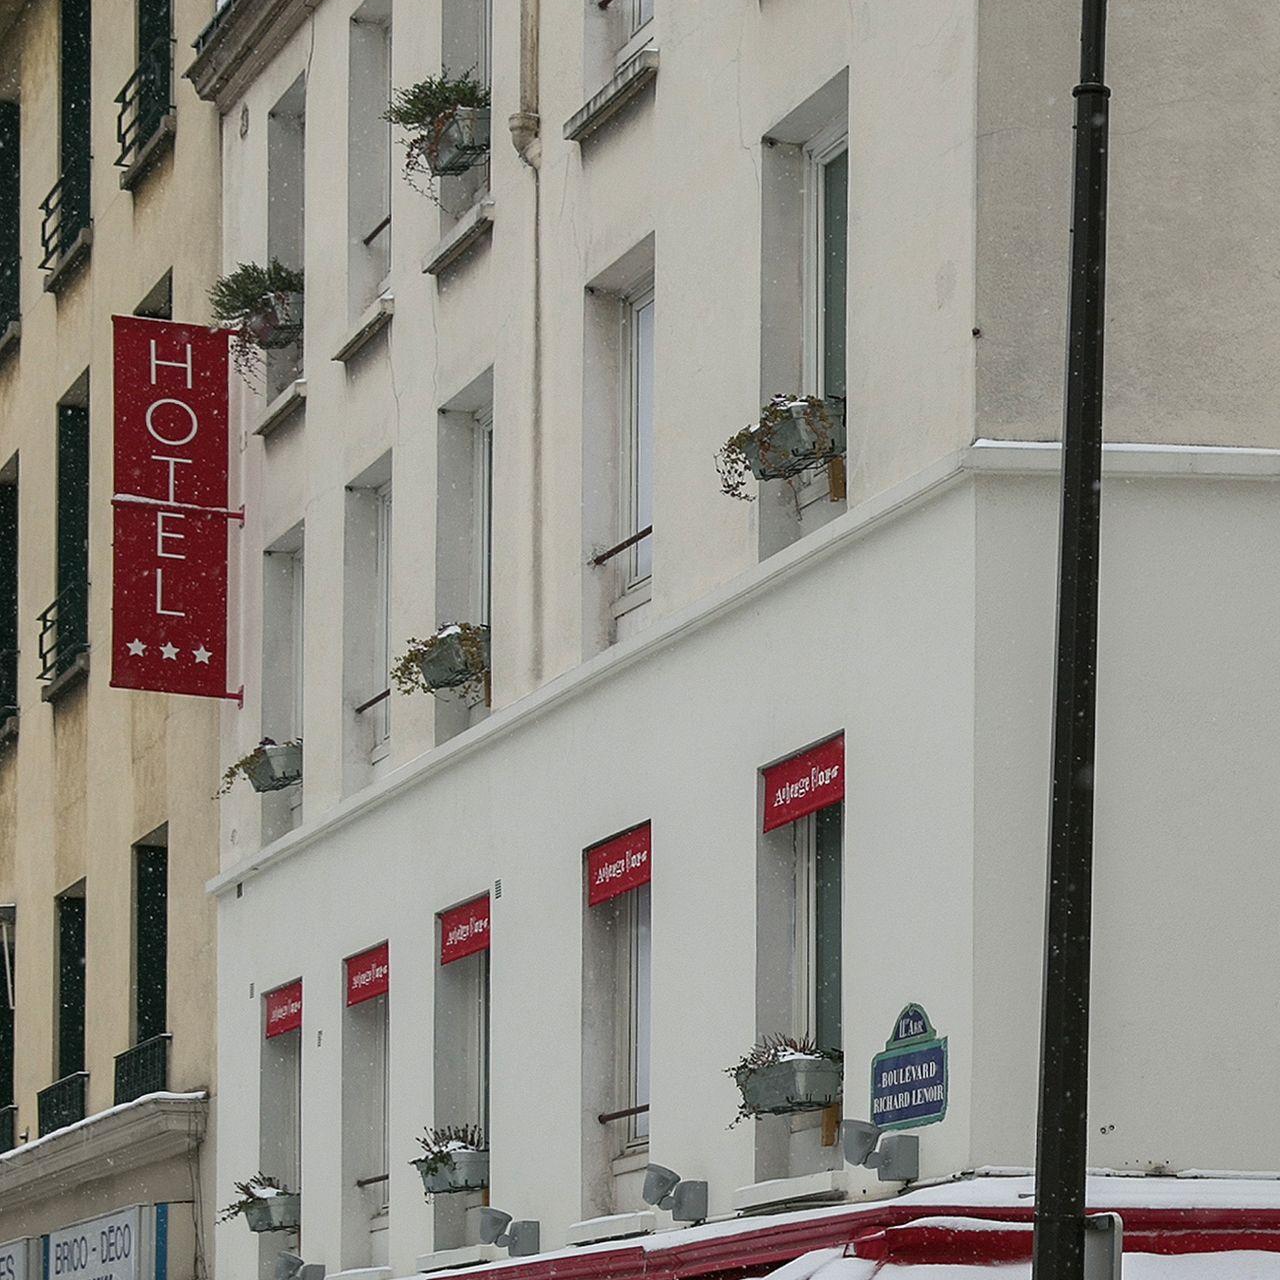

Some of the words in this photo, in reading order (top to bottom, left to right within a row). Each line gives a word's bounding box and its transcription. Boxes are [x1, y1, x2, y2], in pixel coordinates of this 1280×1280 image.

[146, 339, 198, 617] HOTEL
[882, 1061, 936, 1088] BOULEVARD
[873, 1091, 910, 1114] RICHARD
[911, 1084, 943, 1106] LENOIR
[55, 1236, 88, 1275] BRICO
